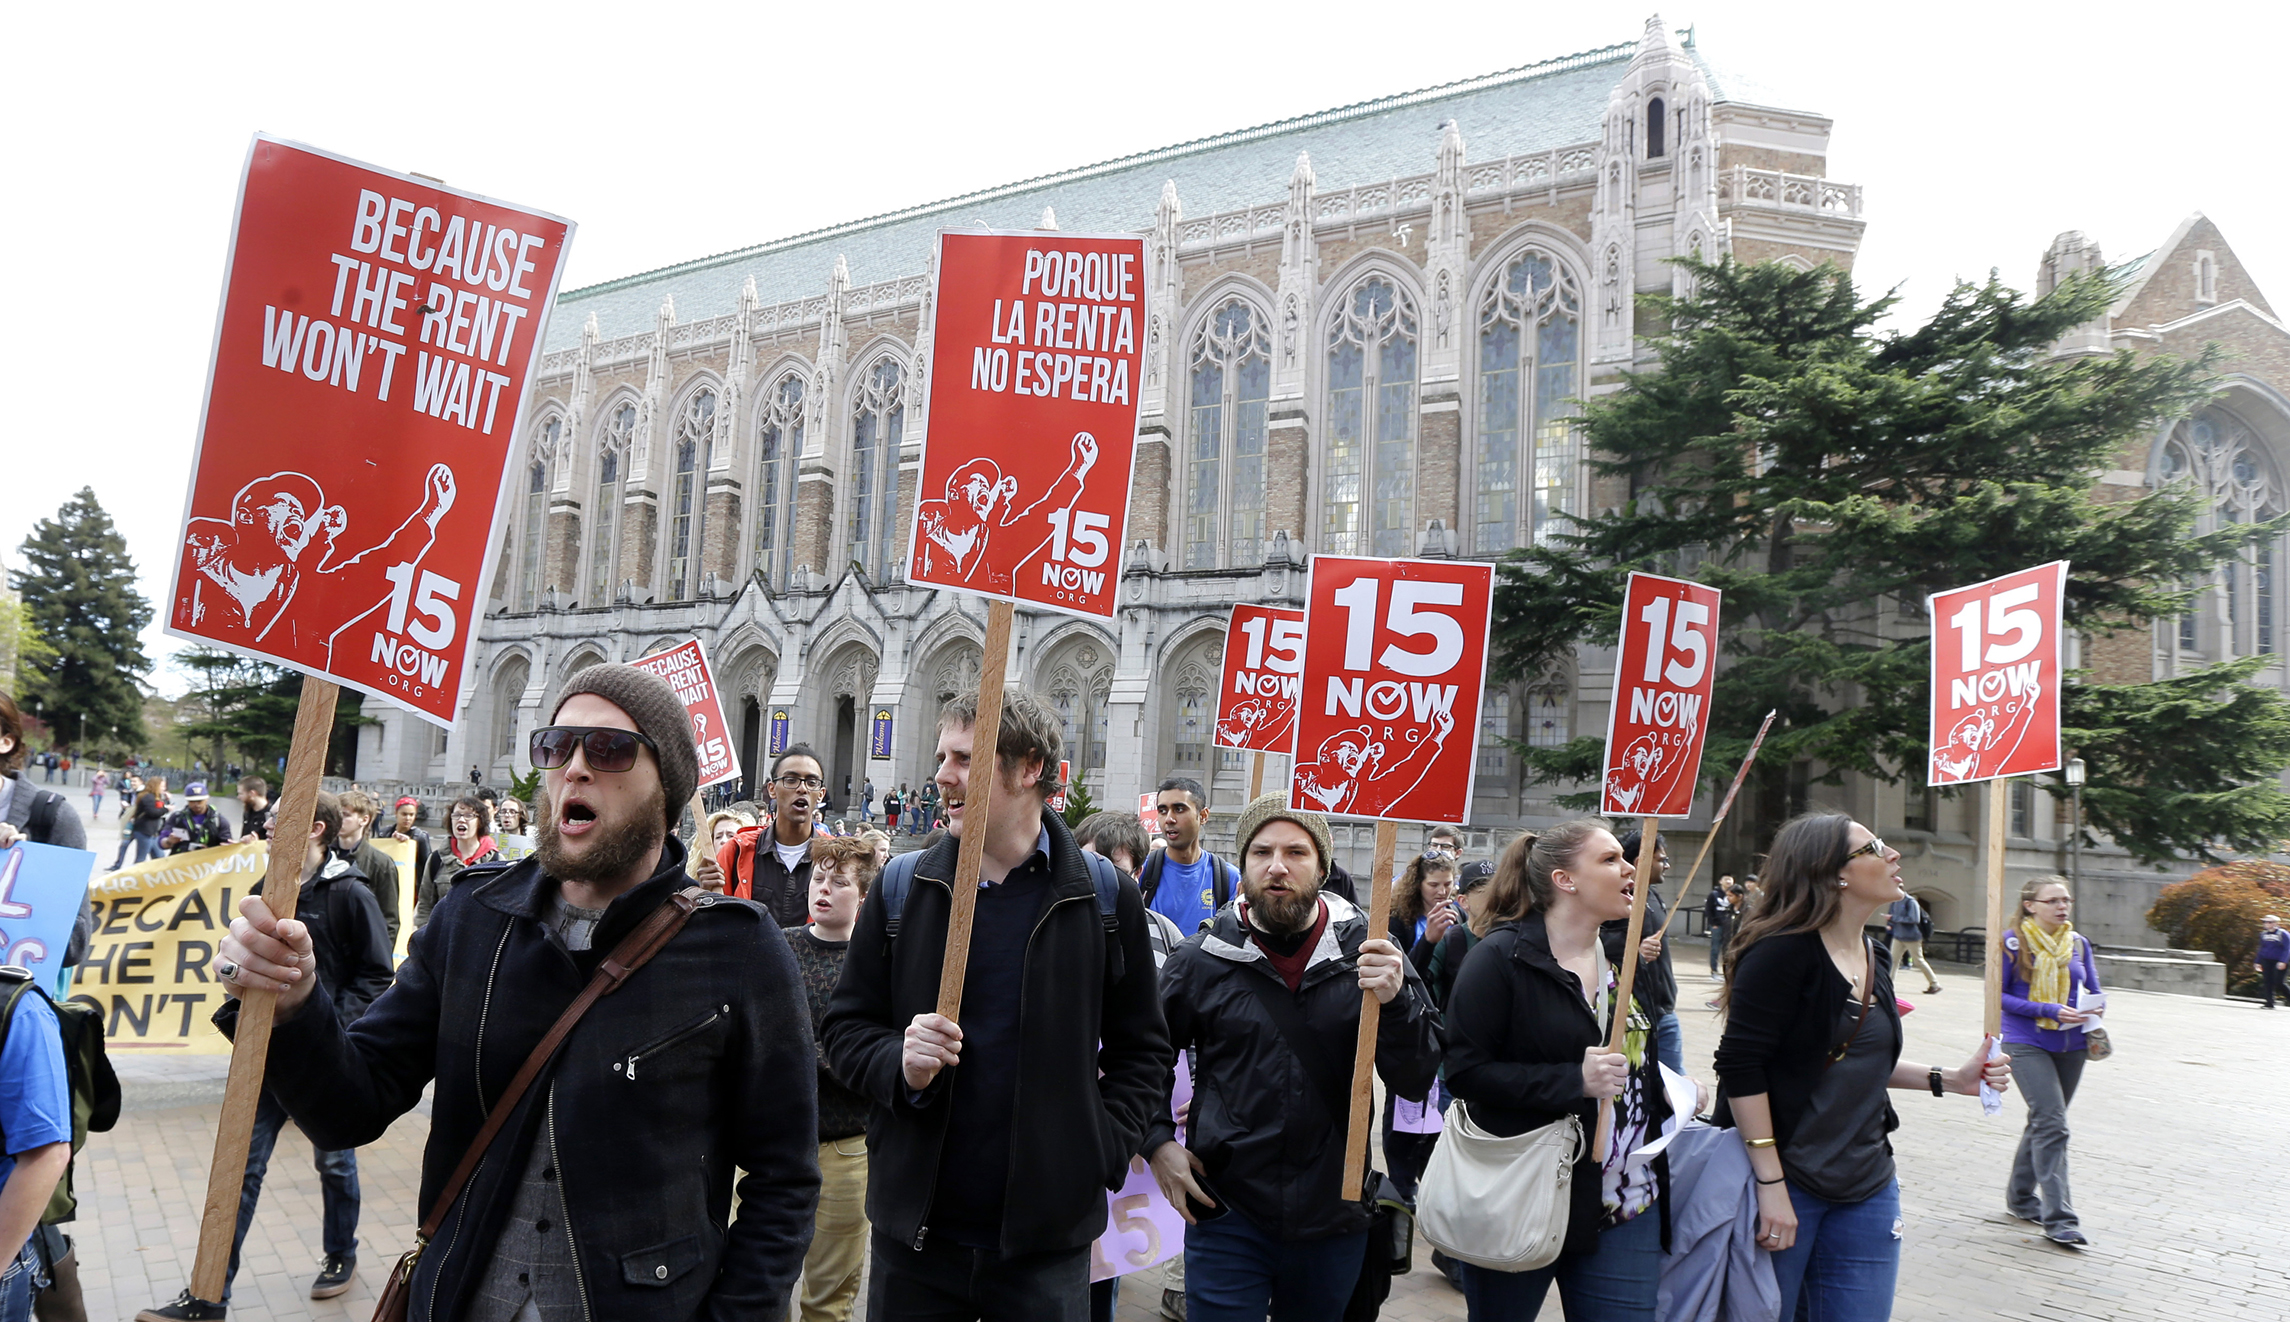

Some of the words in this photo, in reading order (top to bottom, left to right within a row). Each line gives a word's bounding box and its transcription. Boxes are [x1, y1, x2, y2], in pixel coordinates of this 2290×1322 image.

[351, 188, 545, 299] BECAUSE
[1022, 250, 1136, 302] PORQUE
[330, 253, 415, 336] THE
[420, 282, 528, 366] RENT
[991, 299, 1026, 345] LA
[1034, 301, 1134, 354] RENTA
[262, 304, 406, 402] WON'T
[413, 351, 511, 435] WAIT
[971, 347, 1010, 392] NO
[1014, 350, 1129, 405] ESPERA
[1047, 508, 1111, 568] 15
[385, 561, 461, 650] 15
[1042, 562, 1106, 595] NOW
[1241, 616, 1304, 674] 15
[1334, 577, 1464, 677] 15
[1641, 596, 1709, 688] 15
[1951, 582, 2042, 673] 15
[370, 632, 449, 689] NOW
[669, 664, 706, 691] RENT
[1234, 670, 1299, 700] NOW
[1951, 659, 2041, 710] NOW
[1325, 675, 1459, 723] NOW
[1629, 686, 1702, 729] NOW
[697, 736, 726, 766] 15
[875, 721, 886, 756] Welcome
[701, 757, 728, 778] NOW
[145, 853, 256, 889] MINIMUM
